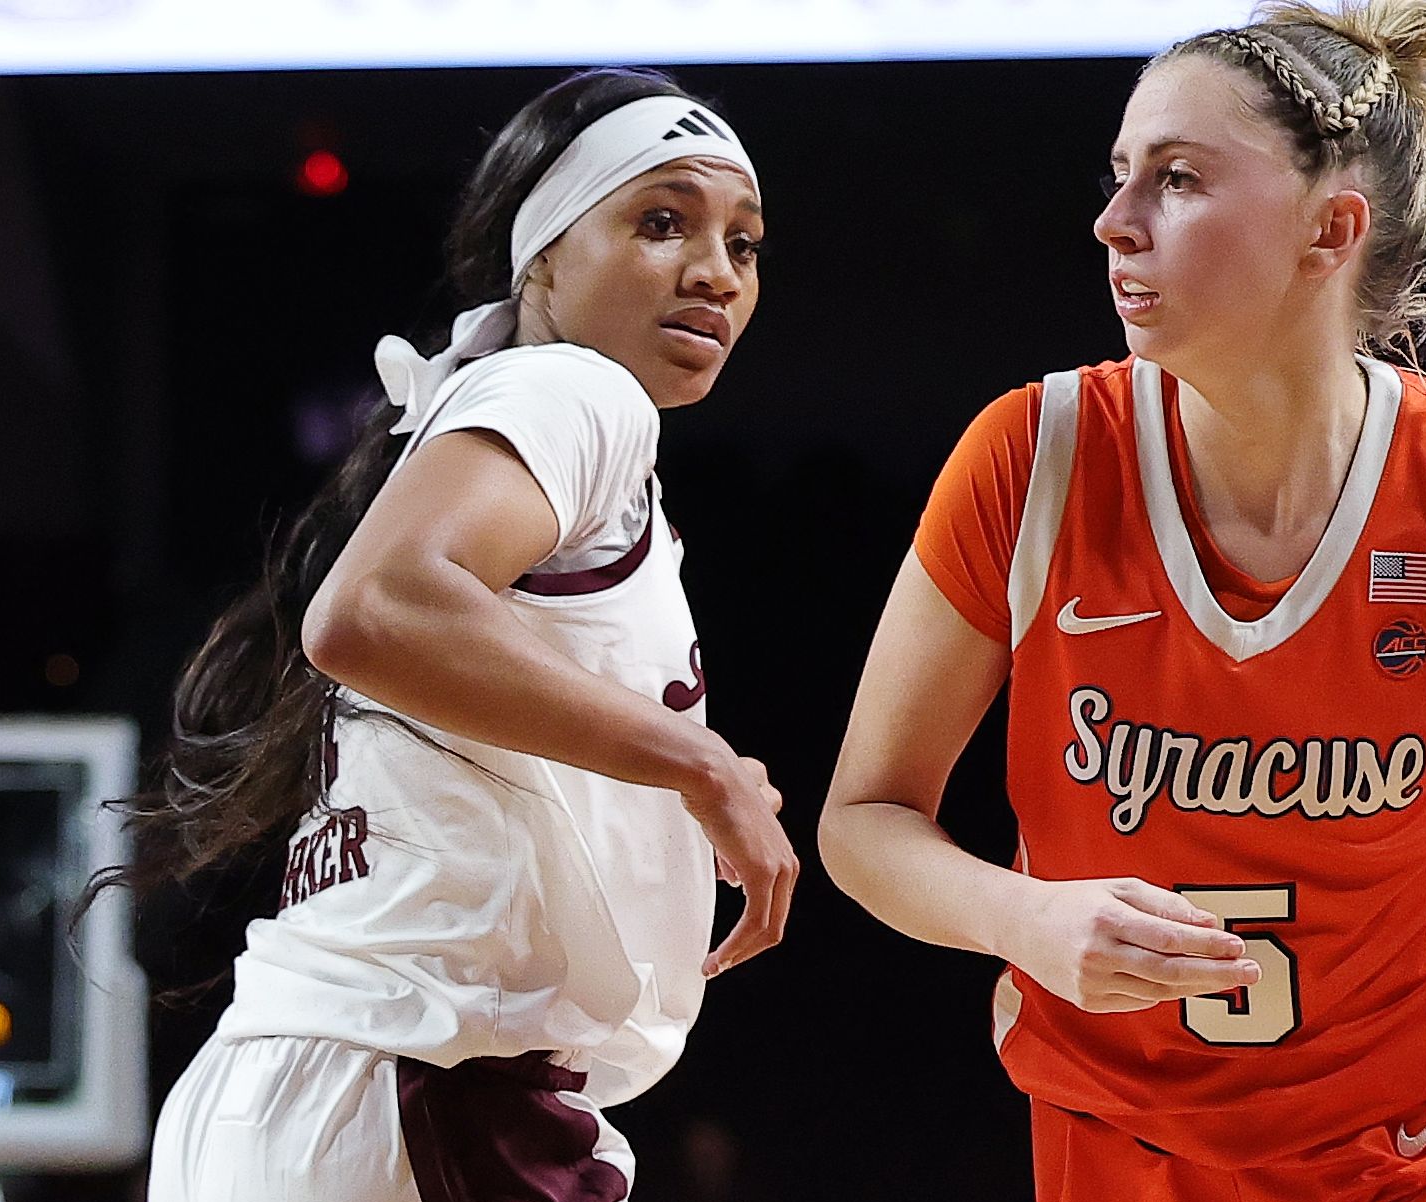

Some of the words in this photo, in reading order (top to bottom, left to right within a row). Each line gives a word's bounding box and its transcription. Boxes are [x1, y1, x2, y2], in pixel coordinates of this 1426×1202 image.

[1380, 636, 1426, 653] ACC
[1064, 685, 1426, 833] Syracuse
[279, 805, 370, 911] RKER
[1176, 882, 1303, 1047] 5
